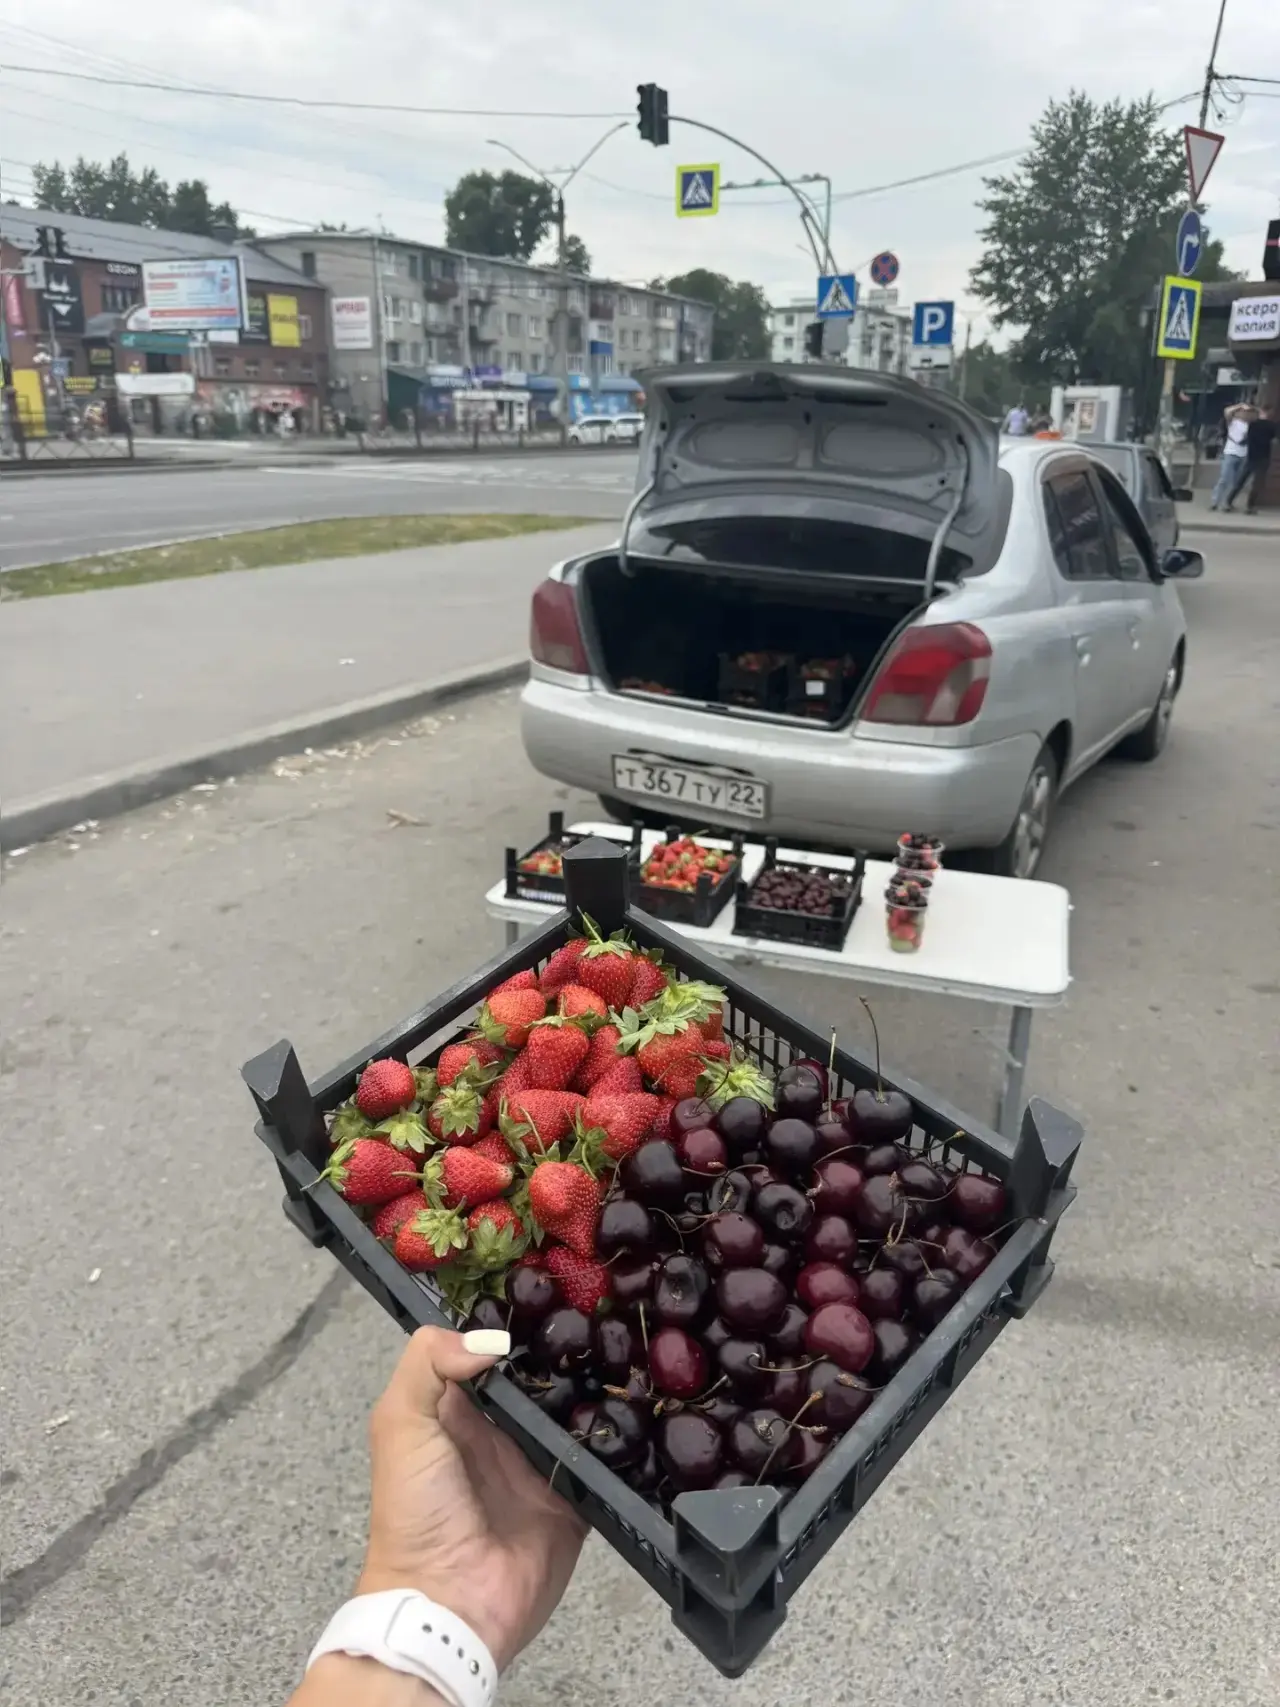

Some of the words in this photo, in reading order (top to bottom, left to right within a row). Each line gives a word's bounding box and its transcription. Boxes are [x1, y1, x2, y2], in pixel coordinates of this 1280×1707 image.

[1237, 303, 1278, 318] ксеро
[922, 307, 947, 342] P
[1234, 320, 1275, 333] копия
